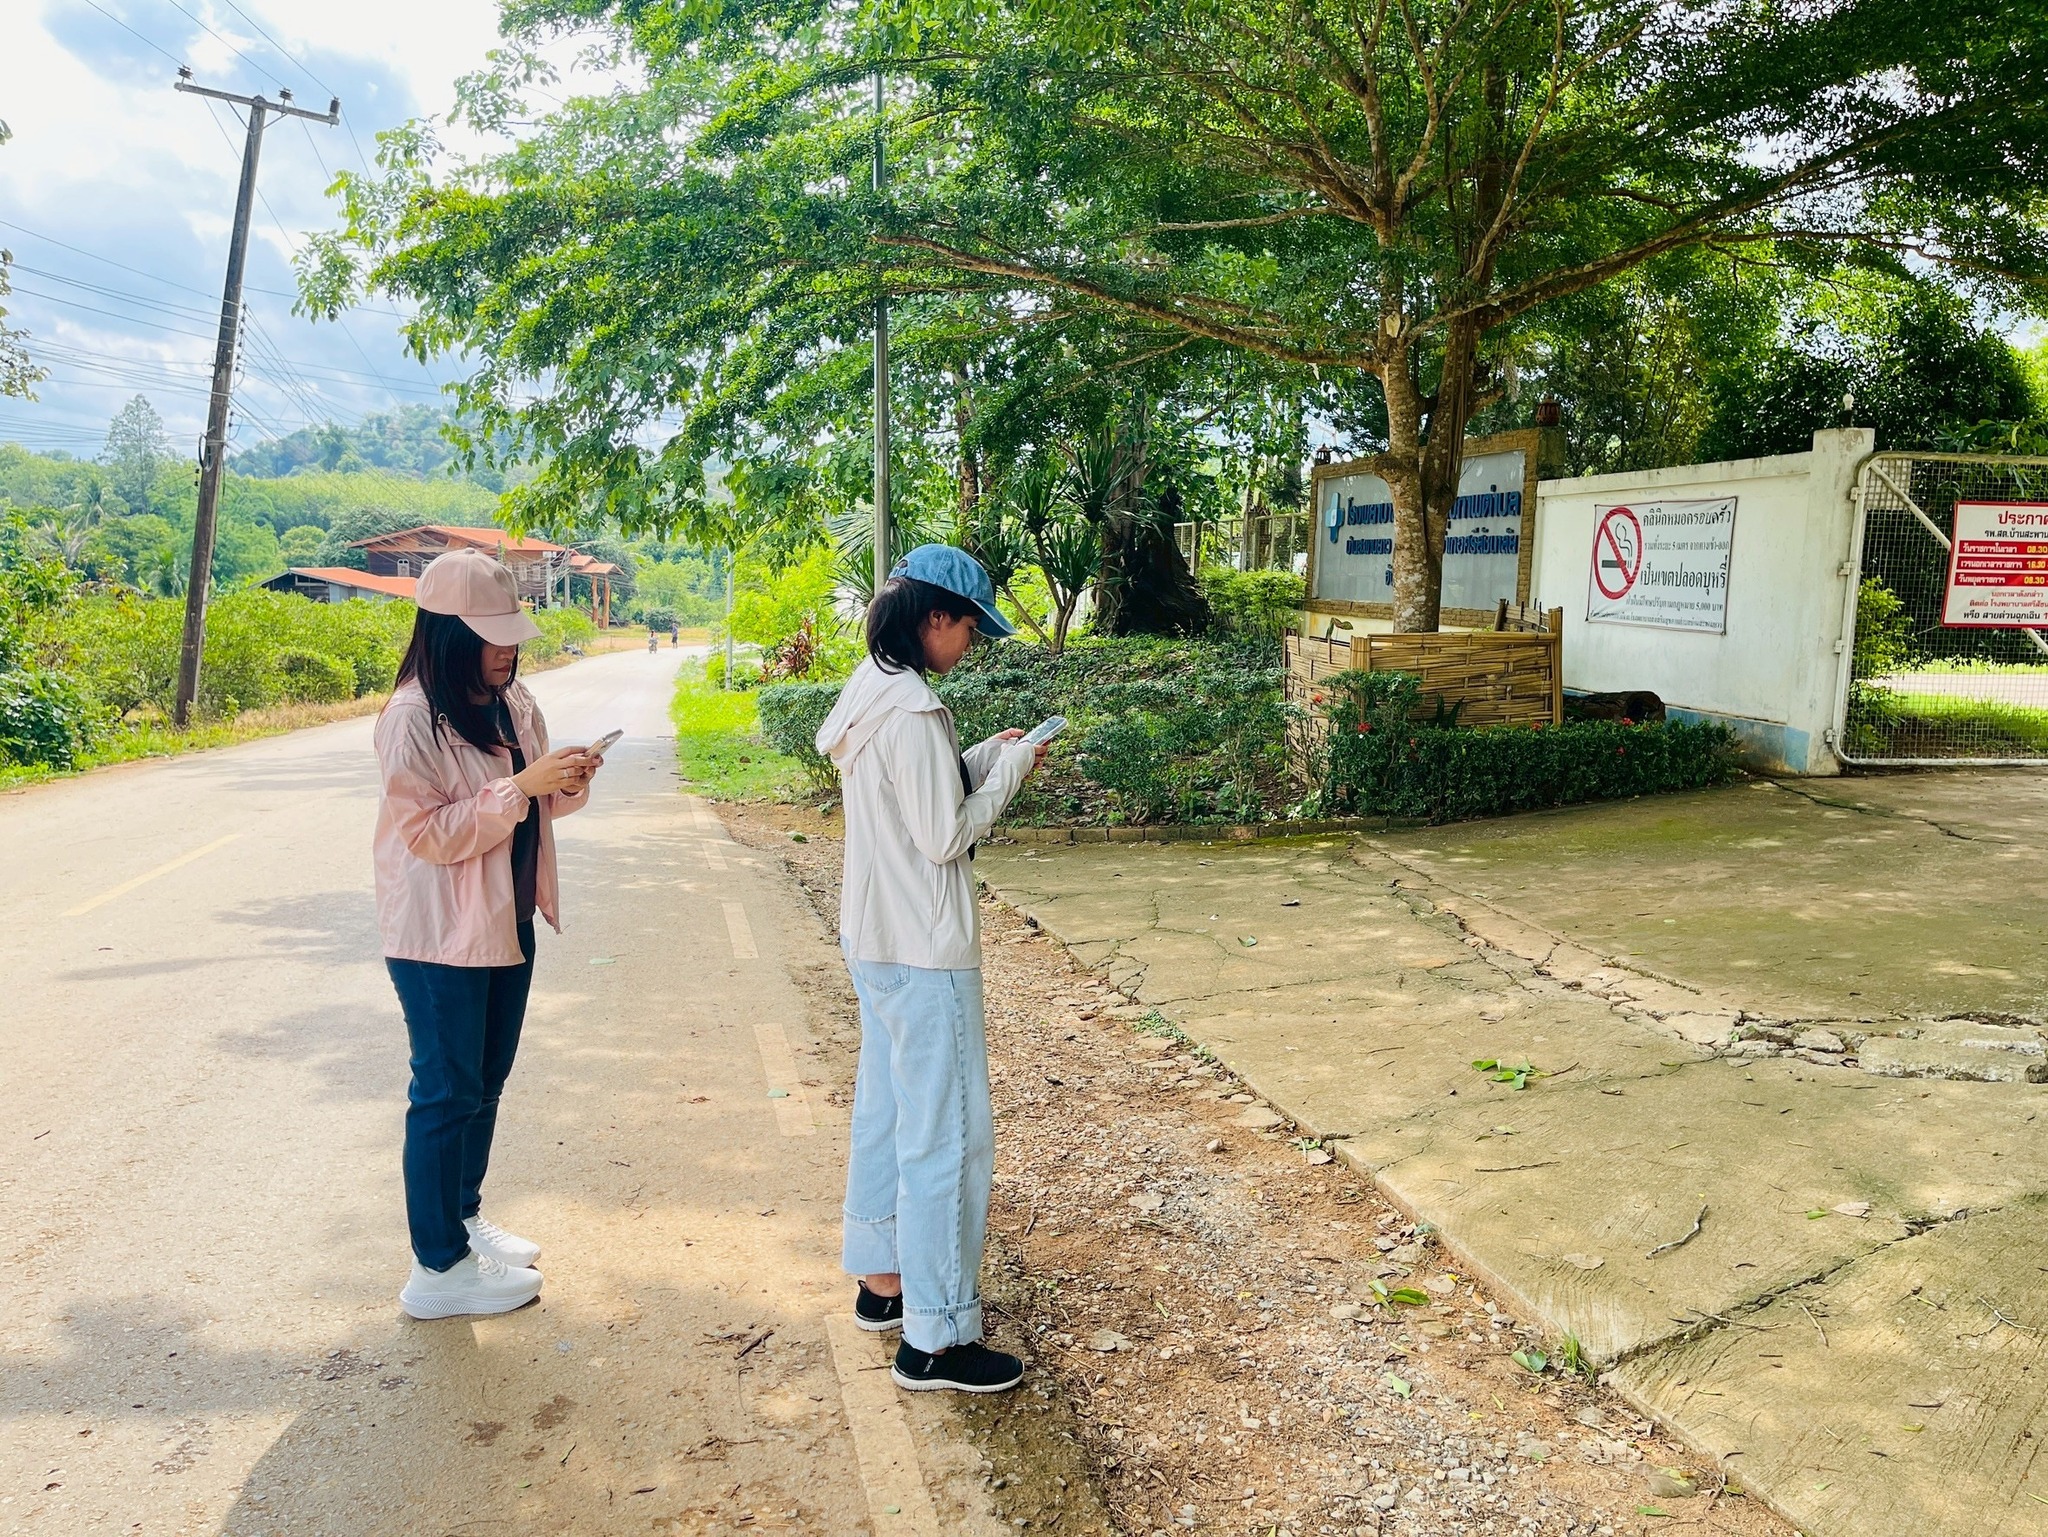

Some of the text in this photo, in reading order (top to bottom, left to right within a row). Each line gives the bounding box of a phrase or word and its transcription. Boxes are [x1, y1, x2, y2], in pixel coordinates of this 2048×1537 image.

[1643, 504, 1731, 527] คลินิกหมอครอบครัว
[1640, 554, 1728, 596] เป็นเขตปลอดบุหรี่
